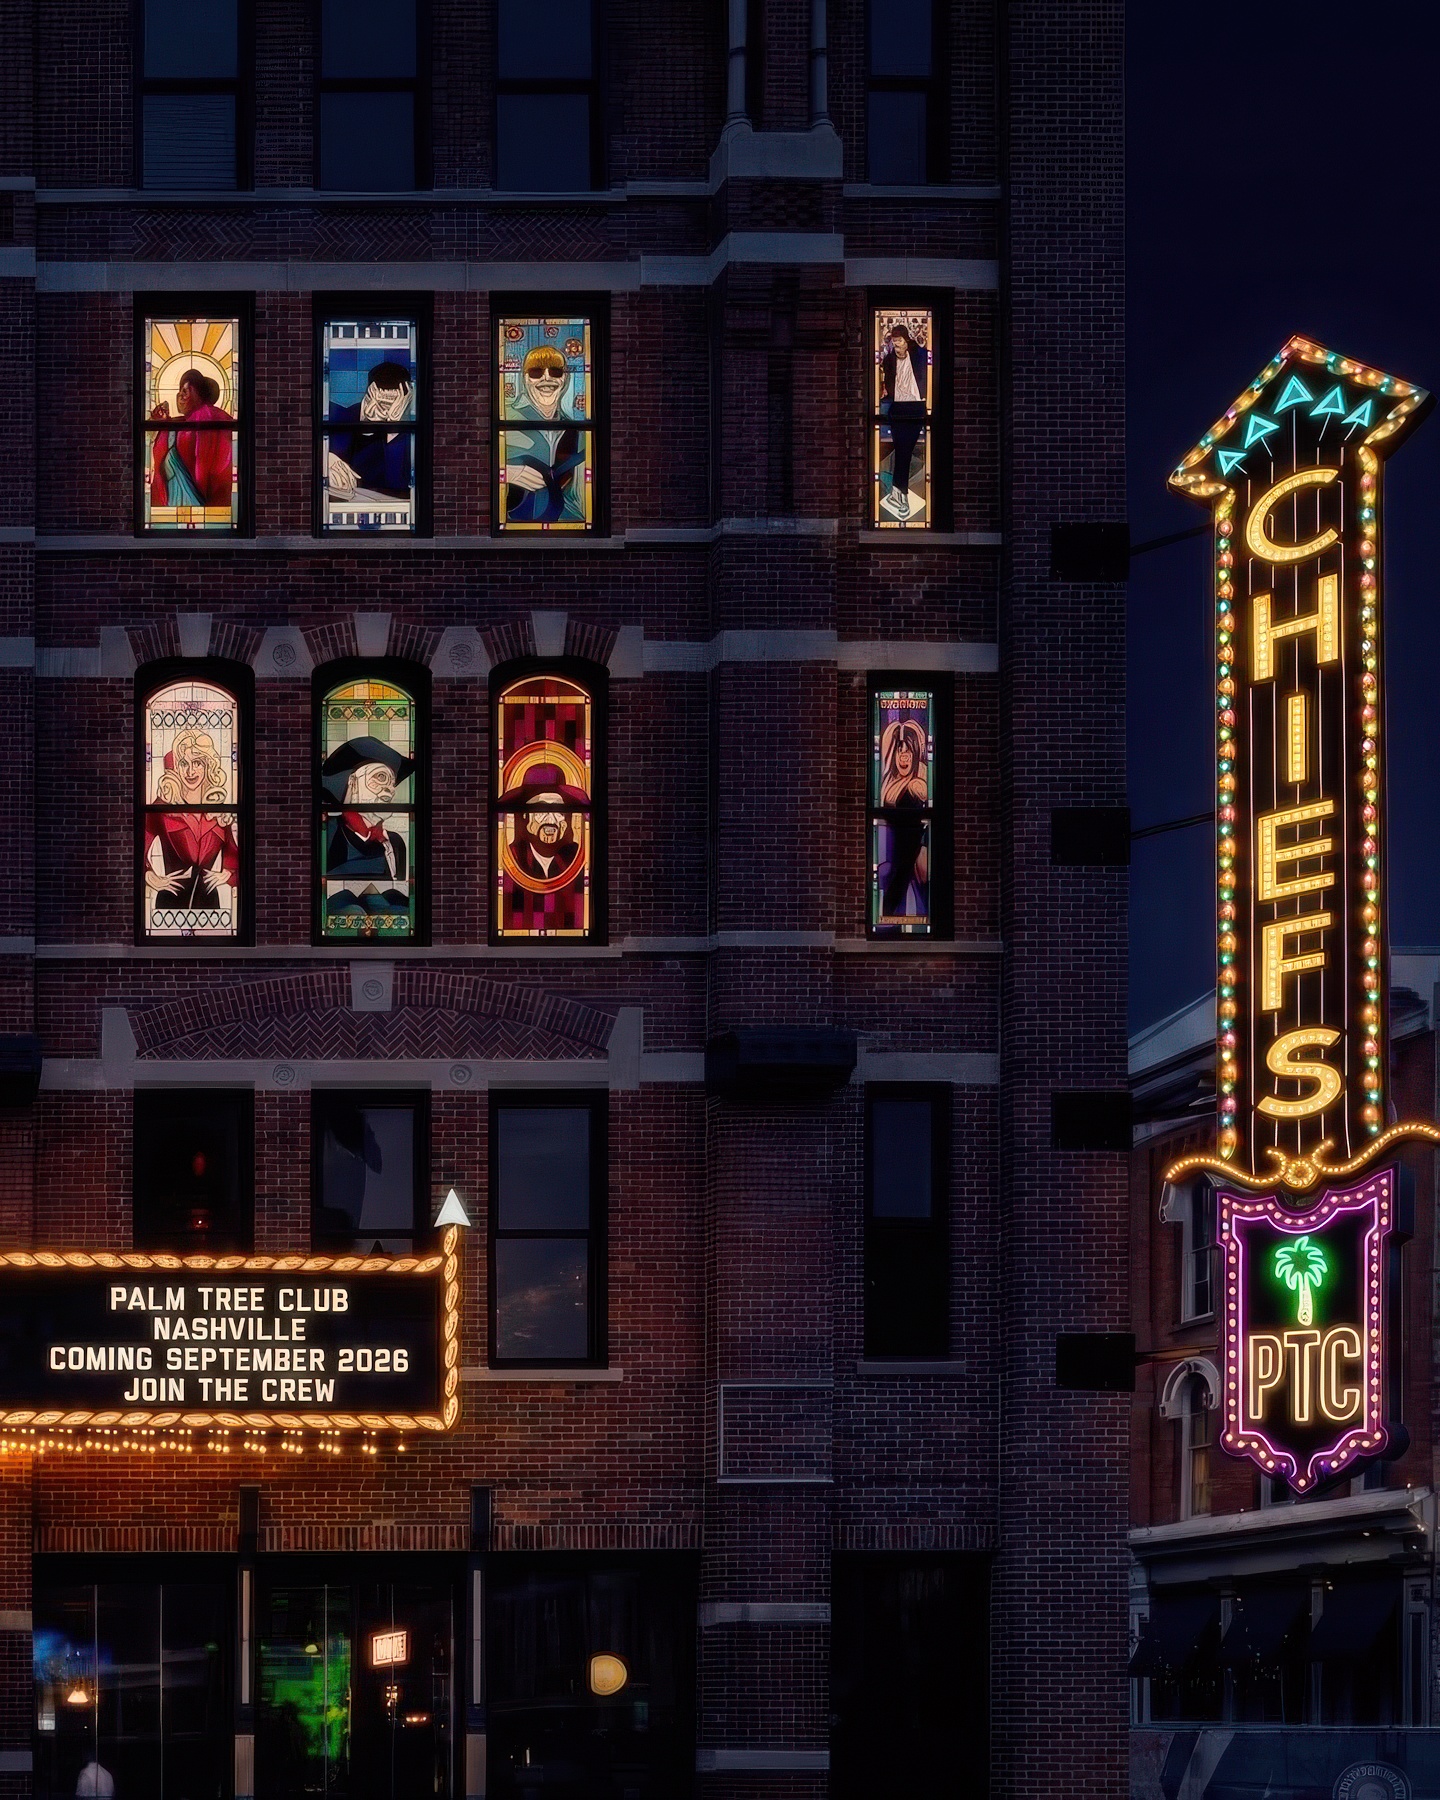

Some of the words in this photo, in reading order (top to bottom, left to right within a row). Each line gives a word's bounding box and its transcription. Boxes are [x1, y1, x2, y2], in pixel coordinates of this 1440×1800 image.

[1246, 468, 1341, 1118] CHIEFS
[110, 1286, 185, 1311] PALM
[197, 1287, 265, 1311] TREE
[278, 1288, 349, 1312] CLUB
[154, 1316, 306, 1341] NASHVILLE
[50, 1346, 153, 1371] COMING
[166, 1347, 325, 1372] SEPTEMBER
[337, 1348, 409, 1373] 2026
[1249, 1327, 1361, 1422] PTC
[123, 1377, 185, 1402] JOIN
[198, 1377, 249, 1402] THE
[262, 1378, 335, 1402] CREW
